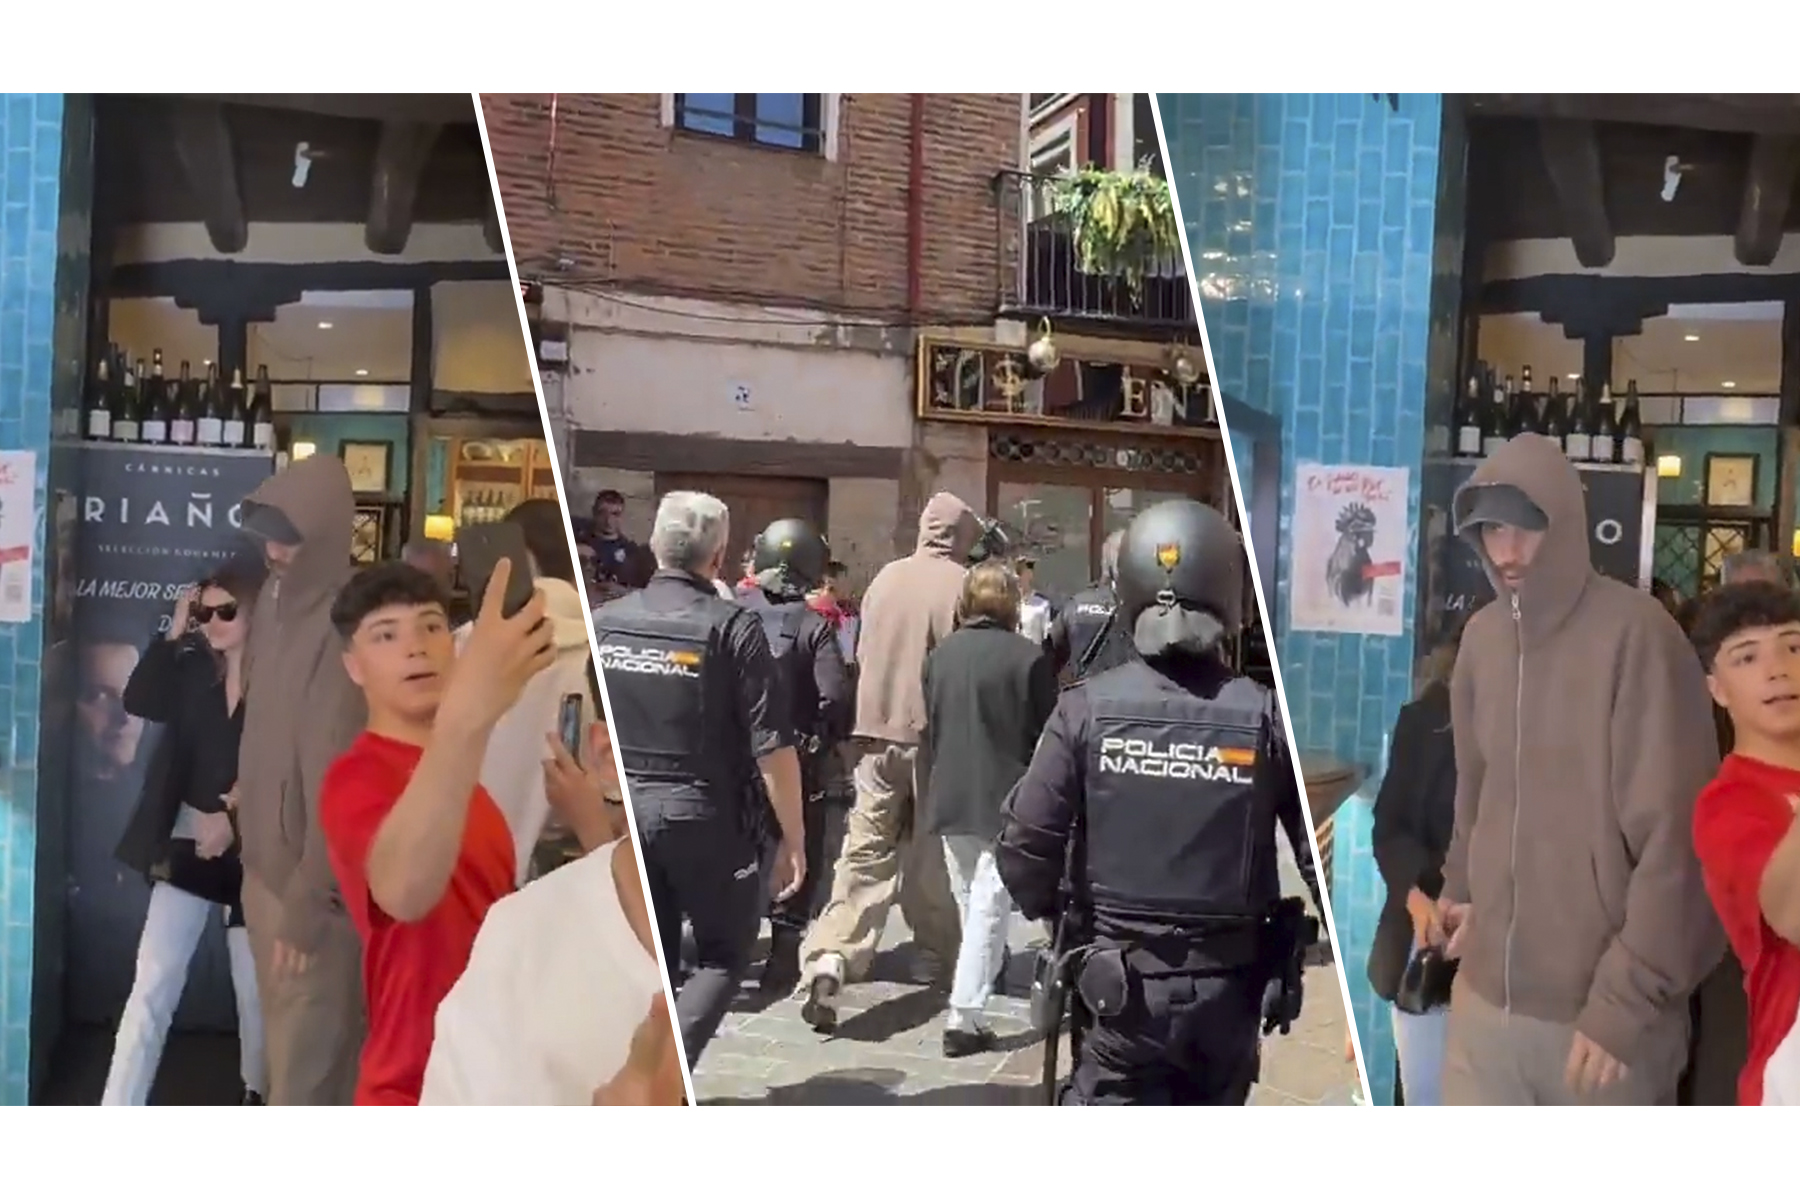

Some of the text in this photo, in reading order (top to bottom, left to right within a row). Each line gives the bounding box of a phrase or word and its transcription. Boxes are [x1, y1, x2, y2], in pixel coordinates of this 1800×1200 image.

[76, 578, 97, 597] LA
[99, 580, 161, 600] MEJOR
[600, 644, 676, 662] POLICIA
[600, 657, 699, 678] NACIONAL
[1101, 737, 1223, 763] POLICIA
[1099, 754, 1253, 784] NACIONAL
